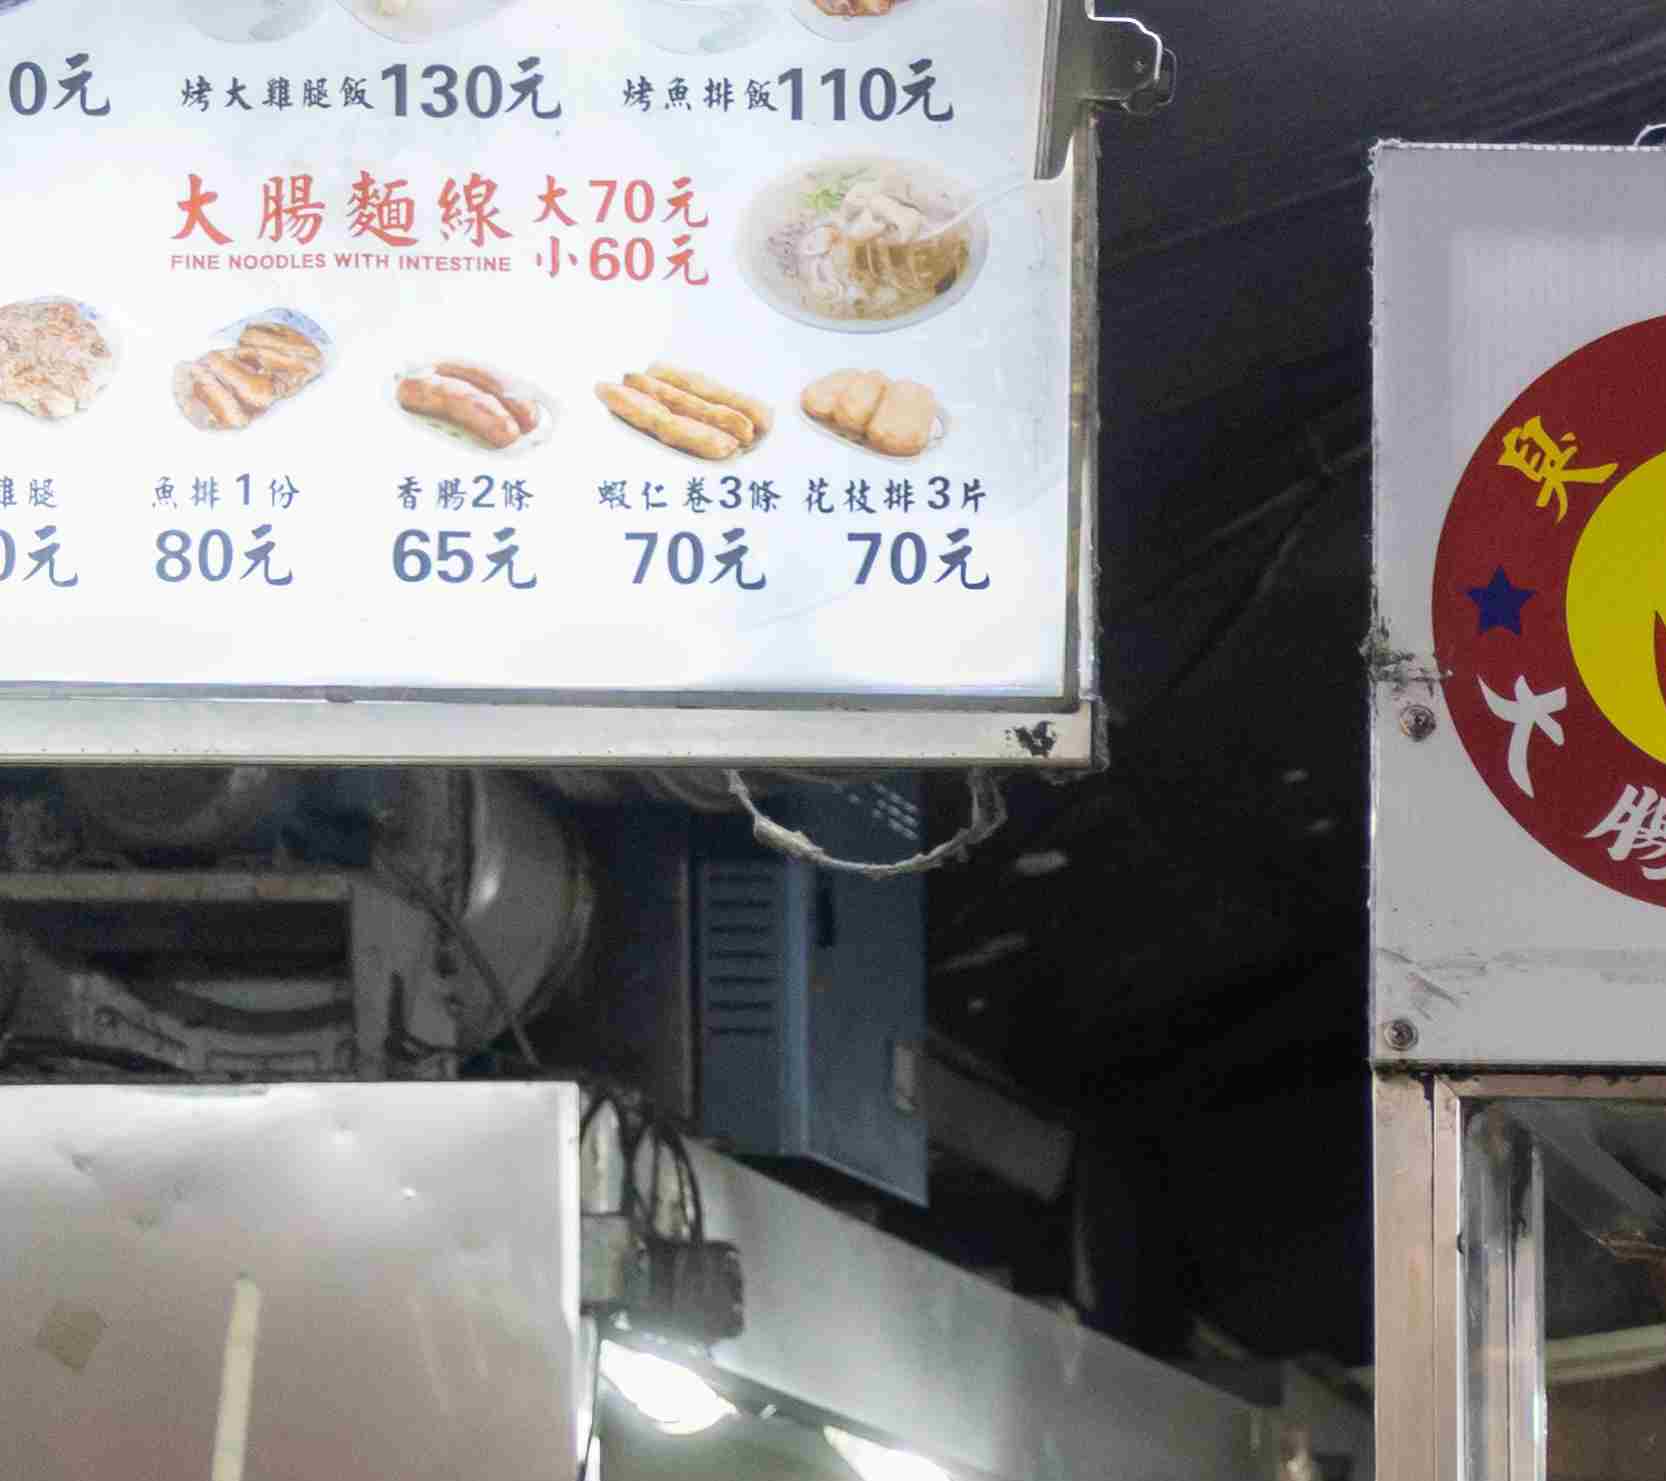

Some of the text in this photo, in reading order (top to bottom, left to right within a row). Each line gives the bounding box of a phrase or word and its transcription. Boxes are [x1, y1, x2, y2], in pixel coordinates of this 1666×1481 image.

[8, 52, 112, 118] 0元
[181, 56, 562, 120] 烤大雞腿飯 130元
[623, 57, 954, 122] 烤魚排飯 110元
[171, 170, 513, 248] 大腸麵線
[533, 174, 710, 228] 大70元
[171, 253, 511, 272] FINE NOODLES WITH INTESTINE
[533, 233, 710, 287] 小60元
[152, 474, 299, 509] 魚排1份
[397, 474, 534, 511] 香腸2條
[805, 475, 987, 514] 花枝排3片
[155, 524, 293, 587] 80元
[392, 527, 538, 590] 65元
[626, 528, 766, 590] 70元
[848, 528, 989, 589] 70元
